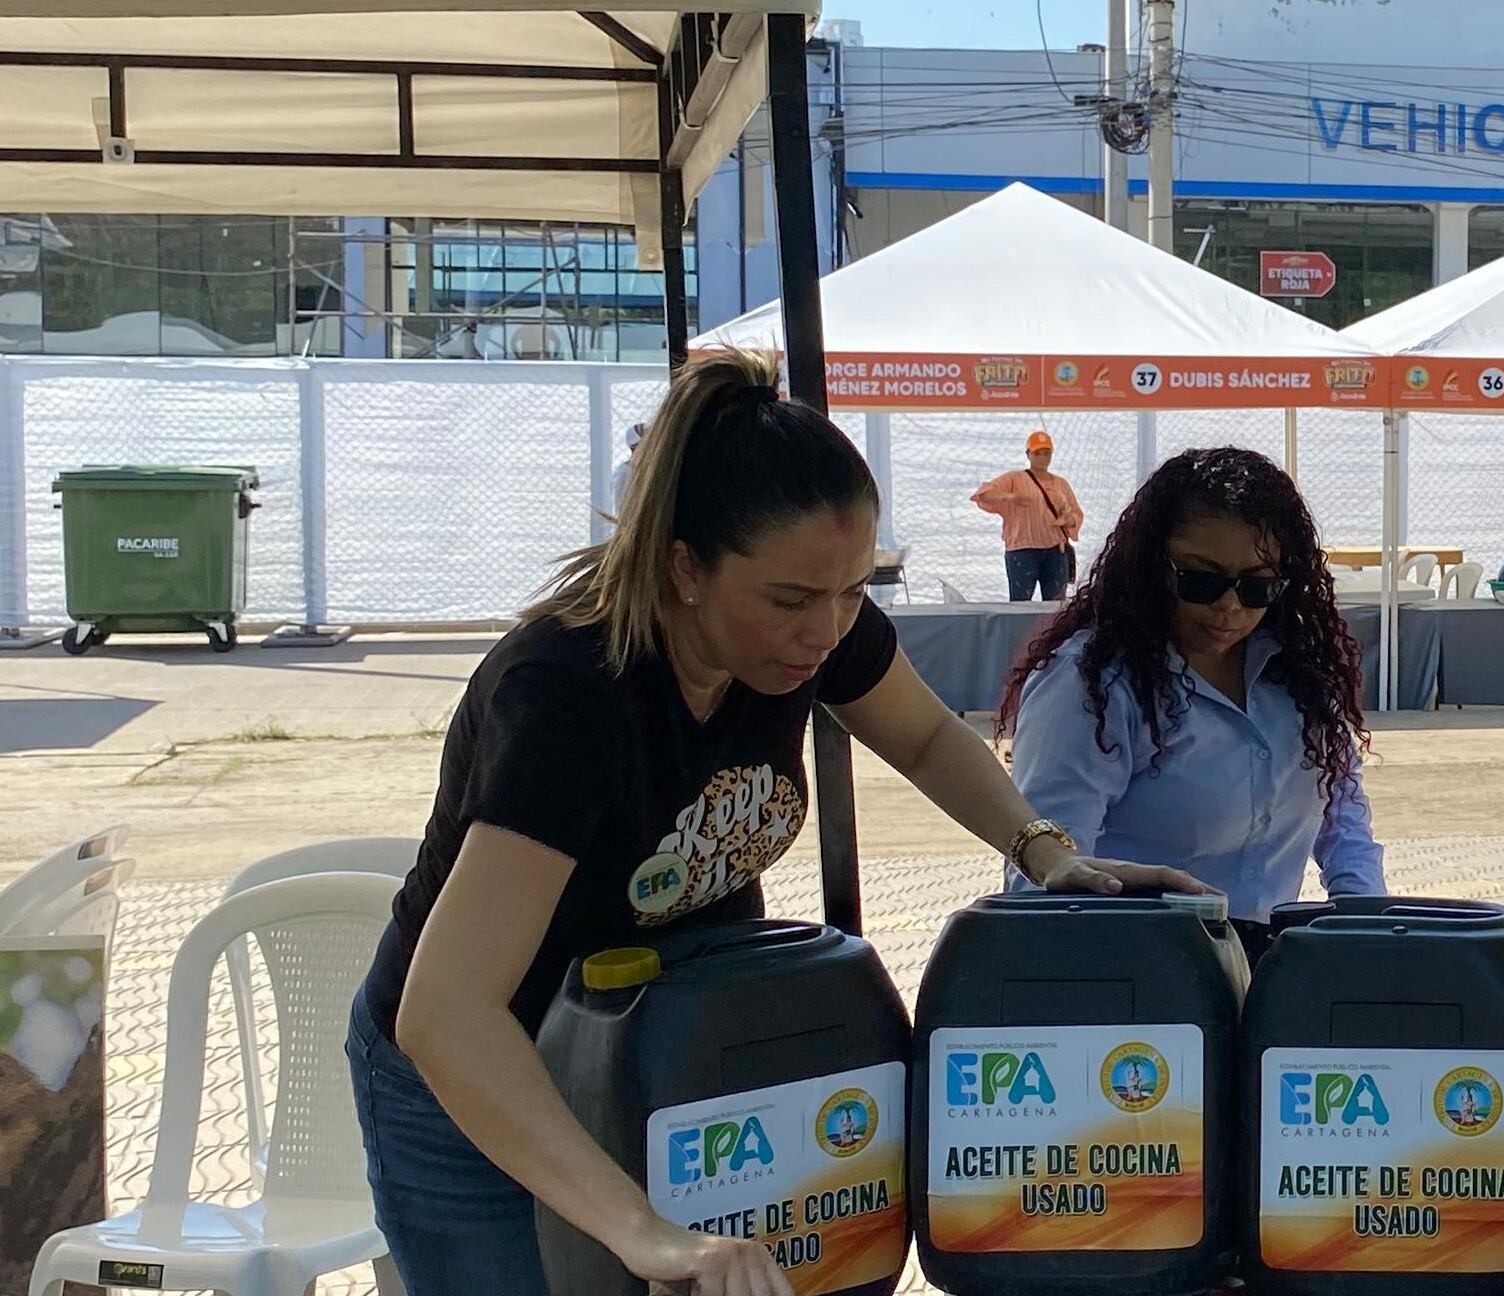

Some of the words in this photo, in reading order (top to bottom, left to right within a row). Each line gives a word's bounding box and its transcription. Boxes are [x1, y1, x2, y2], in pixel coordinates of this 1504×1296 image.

[1268, 268, 1323, 279] ETIQUETA
[1281, 280, 1310, 289] ROJA
[872, 364, 960, 377] ARMANDO
[1137, 372, 1156, 386] 37
[1170, 372, 1223, 387] DUBIS
[1228, 369, 1310, 388] SÁNCHEZ
[826, 379, 880, 395] MÉNEZ
[884, 381, 967, 396] MORELOS
[1483, 377, 1503, 390] 36
[118, 538, 179, 550] PACARIBE
[947, 1052, 1056, 1106] EPA
[1280, 1073, 1390, 1126] EPA
[948, 1108, 1056, 1118] CARTAGENA
[1281, 1128, 1390, 1138] CARTAGENA
[669, 1116, 774, 1185] EPA
[946, 1144, 1035, 1178] ACEITE
[1047, 1144, 1078, 1175] DE
[1089, 1143, 1181, 1175] COCINA
[670, 1167, 775, 1198] CARTAGENA
[1279, 1165, 1368, 1196] ACEITE
[1380, 1166, 1410, 1197] DE
[766, 1200, 794, 1235] DE
[805, 1179, 890, 1225] COCINA
[1022, 1183, 1106, 1214] USADO
[1354, 1205, 1440, 1236] USADO
[776, 1232, 822, 1269] ADO
